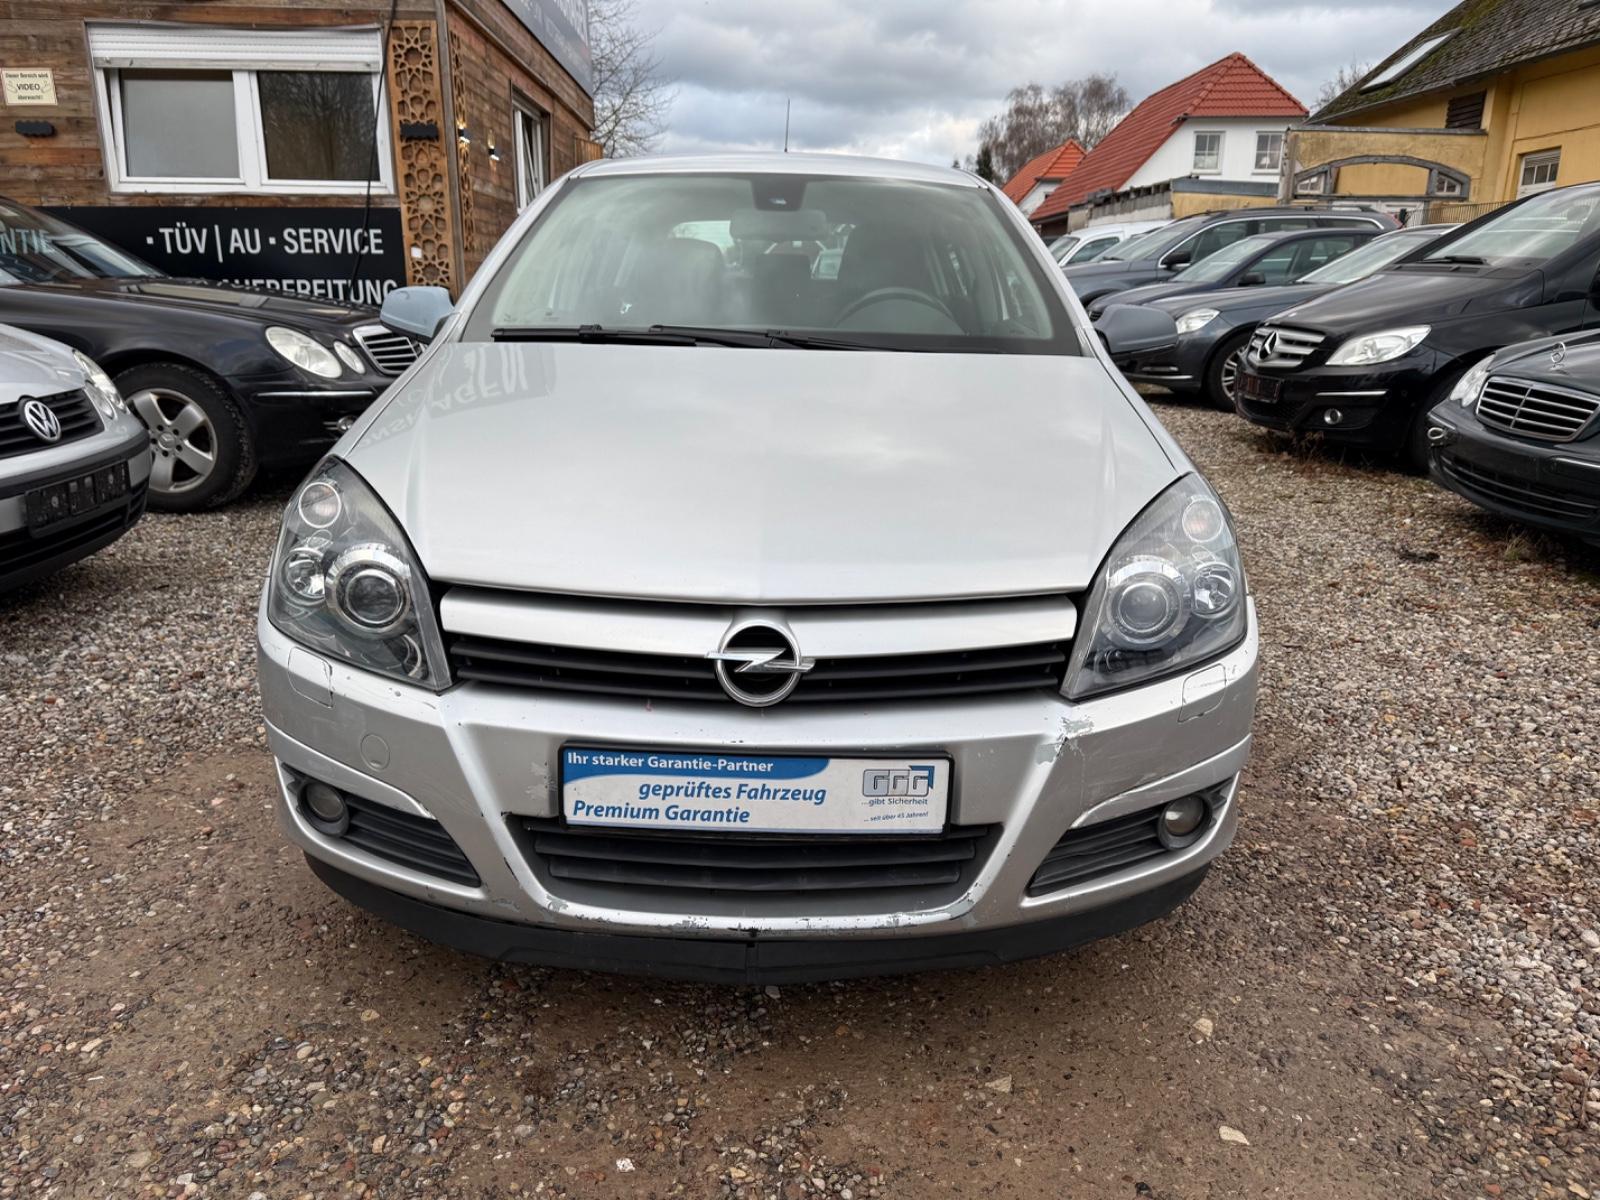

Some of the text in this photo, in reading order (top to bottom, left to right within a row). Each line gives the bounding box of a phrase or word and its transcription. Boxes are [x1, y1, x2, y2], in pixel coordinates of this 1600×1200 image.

[17, 83, 41, 91] VIDEO
[159, 222, 384, 254] TÜV AU SERVICE
[567, 752, 774, 773] Ihr starker Garantie-Partner
[639, 781, 827, 806] geprüftes Fahrzeug
[887, 797, 928, 805] Sicherheit
[573, 800, 751, 823] Premium Garantie
